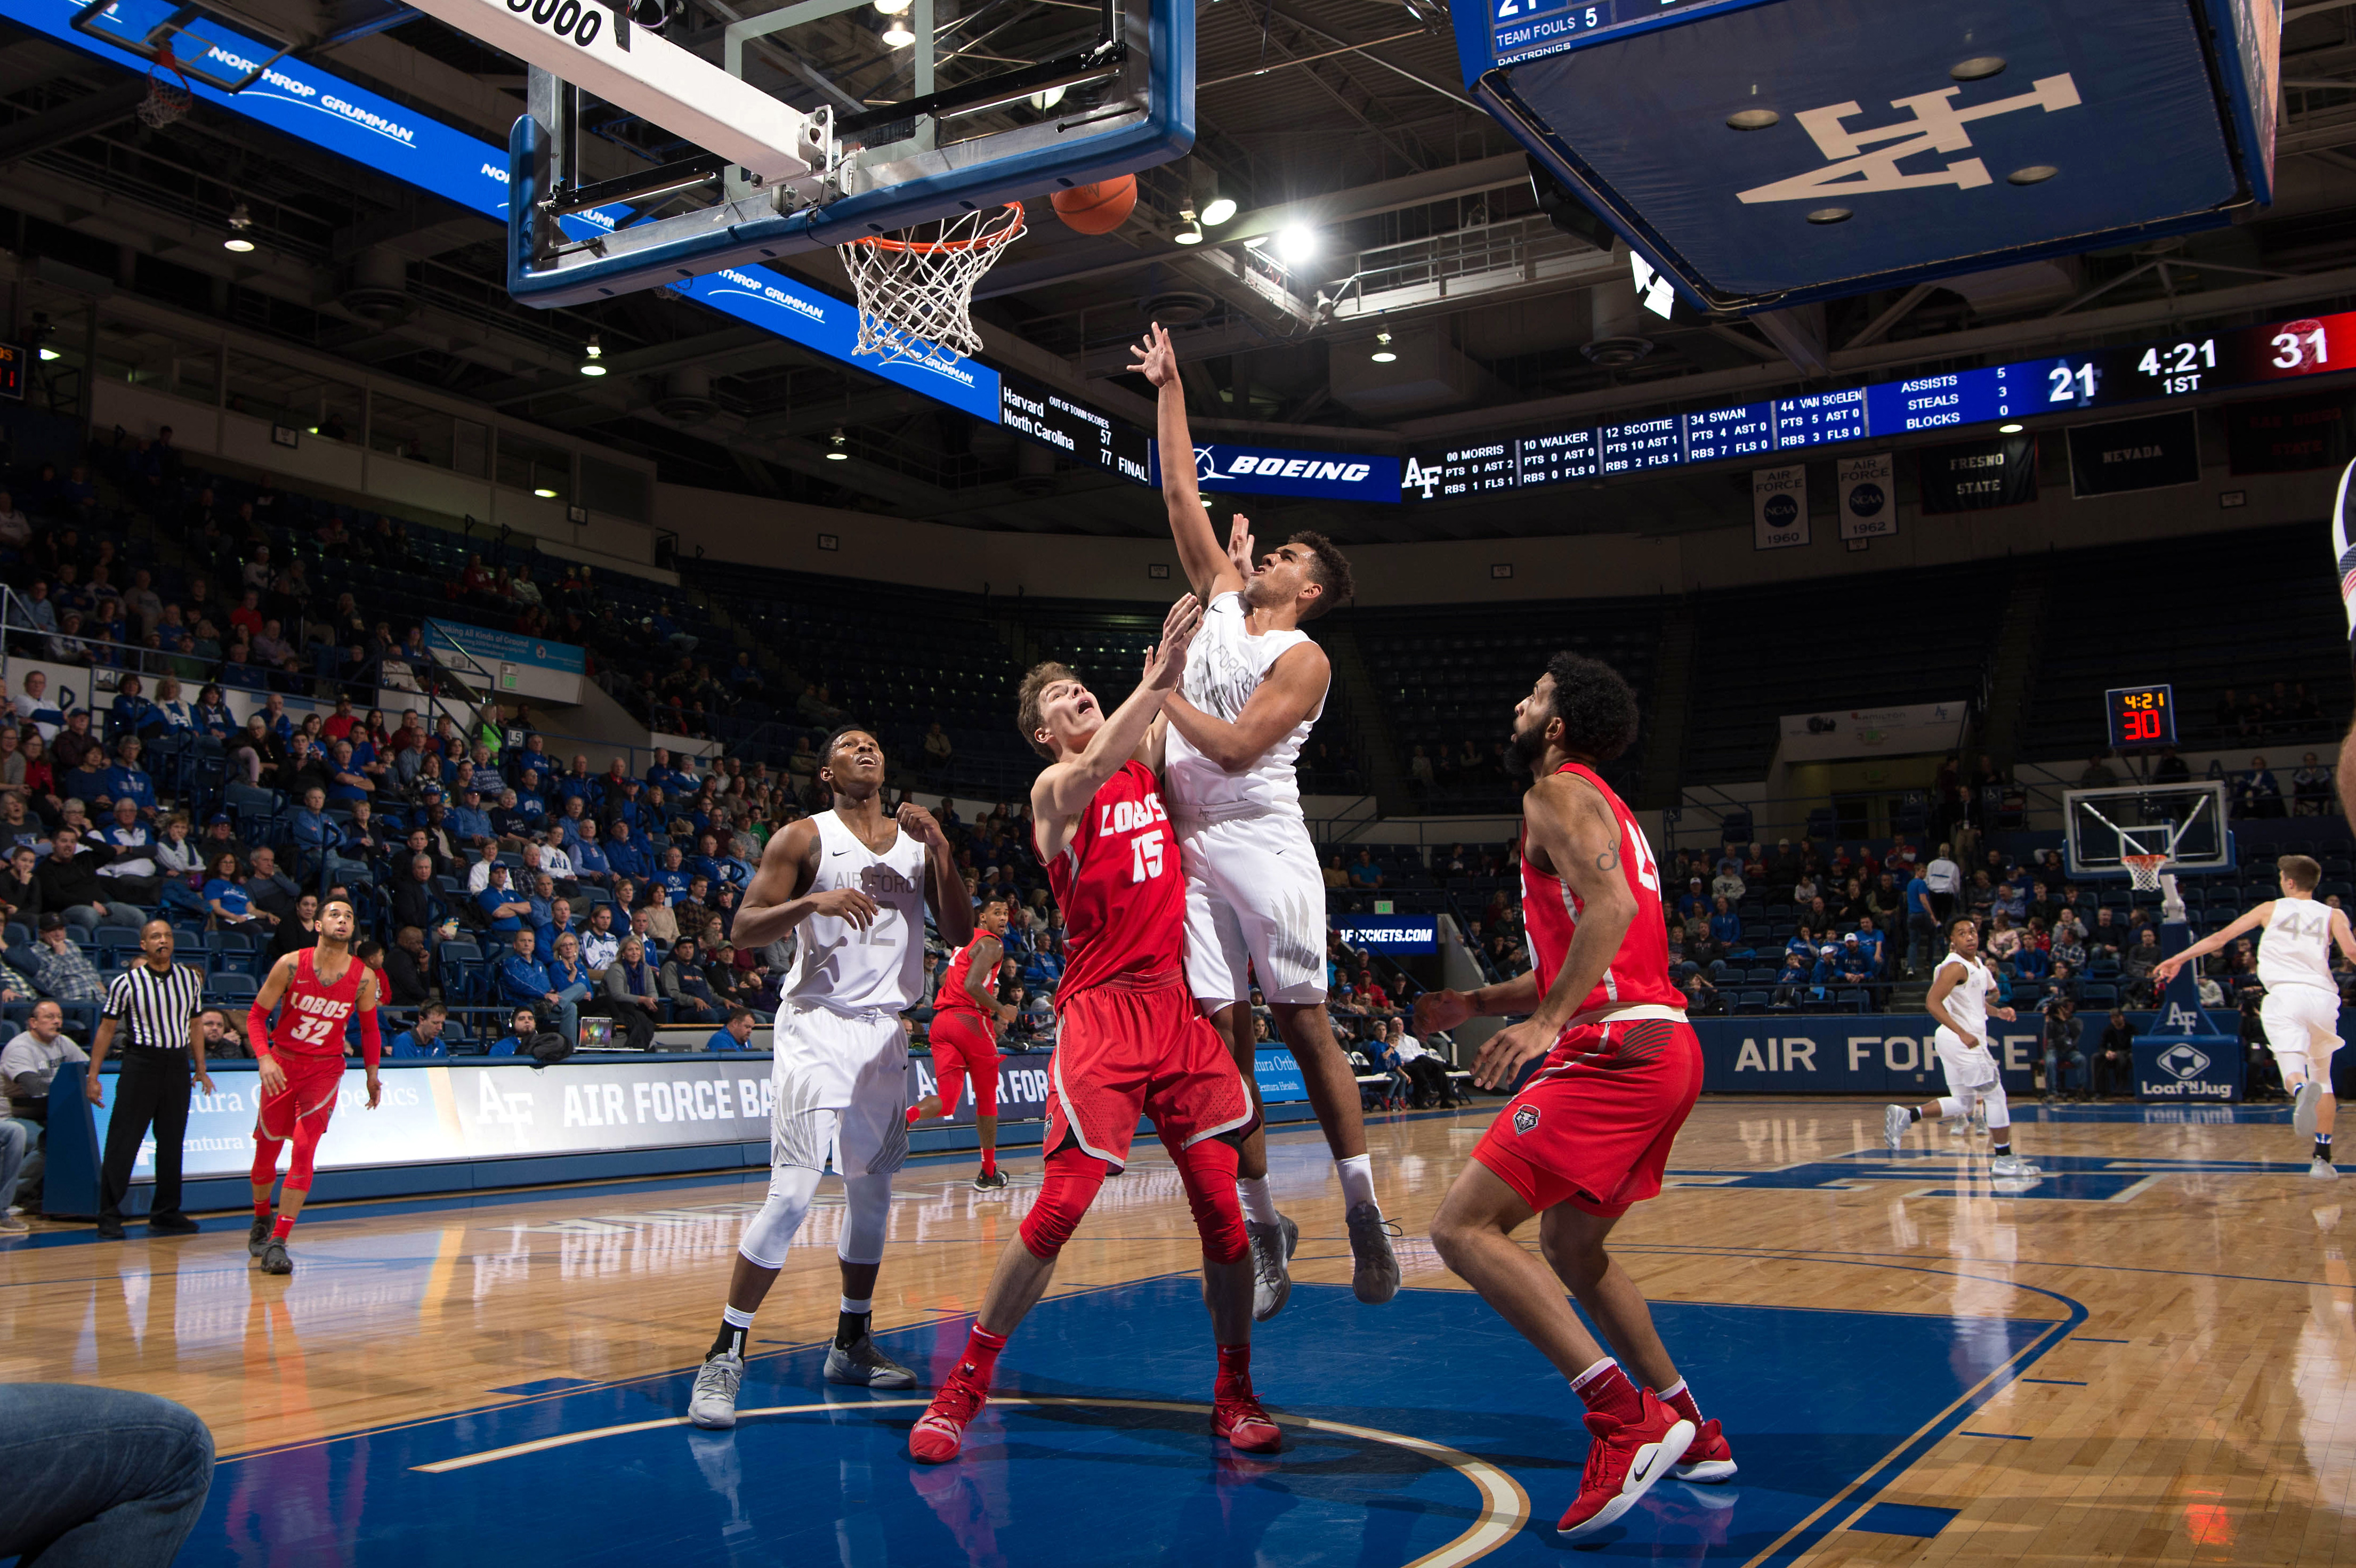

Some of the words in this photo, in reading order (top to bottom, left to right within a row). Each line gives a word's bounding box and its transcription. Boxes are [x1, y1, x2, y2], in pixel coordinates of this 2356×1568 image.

[1496, 28, 1531, 47] TEAM
[1534, 17, 1576, 36] FOULS
[1585, 7, 1597, 28] 5
[1497, 42, 1571, 67] DAKTRONICS
[320, 94, 414, 142] GRUMMAN
[764, 286, 824, 319] GRUMMAN
[2137, 338, 2216, 378] 4:21
[2269, 328, 2328, 370] 31
[925, 357, 974, 384] GRUMMAN
[1900, 375, 1958, 394] ASSISTS
[1996, 367, 2006, 379] 5
[2048, 362, 2095, 403] 21
[2162, 373, 2201, 395] 1ST
[1780, 401, 1795, 412] 44
[1800, 396, 1819, 409] VAN
[1822, 390, 1862, 406] SOELEN
[1907, 392, 1959, 411] STEALS
[1998, 385, 2007, 398] 3
[1004, 386, 1044, 418] Harvard
[1100, 429, 1111, 446] 57
[1049, 396, 1060, 409] OUT
[1061, 400, 1070, 412] OF
[1070, 403, 1087, 421] TOWN
[1087, 411, 1109, 430] SCORES
[1690, 414, 1705, 426] 34
[1708, 407, 1746, 423] SWAN
[1780, 416, 1803, 429] PTS
[1811, 414, 1819, 424] 5
[1825, 409, 1849, 422] AST
[1852, 408, 1859, 418] 0
[1906, 411, 1960, 430] BLOCKS
[1999, 405, 2008, 416] 0
[1605, 427, 1619, 438] 12
[1624, 418, 1673, 435] SCOTTIE
[1691, 430, 1714, 442] PTS
[1720, 427, 1726, 438] 4
[1734, 423, 1756, 436] AST
[1760, 422, 1767, 432] 0
[1781, 434, 1805, 447] RBS
[1812, 432, 1820, 442] 3
[1827, 429, 1849, 440] FLS
[1853, 426, 1861, 437] 0
[1004, 408, 1032, 434] North
[1034, 421, 1075, 451] Carolina
[1100, 448, 1112, 466] 77
[1118, 456, 1148, 482] FINAL
[1523, 439, 1537, 451] 10
[1539, 432, 1588, 449] WALKER
[1606, 442, 1627, 454] PTS
[1631, 440, 1644, 451] 10
[1647, 436, 1668, 449] AST
[1672, 435, 1677, 445] 1
[1691, 447, 1715, 460] RBS
[1721, 446, 1728, 456] 7
[1736, 441, 1757, 453] FLS
[1761, 439, 1768, 449] 0
[1446, 452, 1458, 462] 00
[1461, 444, 1504, 460] MORRIS
[1523, 455, 1545, 466] PTS
[1551, 452, 1558, 463] 0
[1564, 448, 1585, 460] AST
[1588, 447, 1594, 457] 0
[1605, 459, 1628, 472] RBS
[1635, 457, 1642, 468] 2
[1648, 454, 1669, 466] FLS
[1673, 452, 1678, 463] 1
[1949, 453, 2005, 471] FRESNO
[2102, 444, 2164, 464] NEVADA
[1228, 455, 1370, 481] BOEING
[1445, 466, 1465, 478] PTS
[1472, 464, 1479, 474] 0
[1484, 460, 1504, 472] AST
[1507, 459, 1513, 469] 2
[1523, 472, 1545, 484] RBS
[1551, 470, 1558, 479] 0
[1564, 466, 1585, 478] FLS
[1588, 464, 1595, 474] 0
[1766, 470, 1790, 480] AIR
[1840, 467, 1890, 482] FORCE
[1853, 459, 1876, 470] AIR
[1401, 457, 1442, 499] AF
[1445, 483, 1466, 495] RBS
[1473, 481, 1478, 491] 1
[1484, 478, 1504, 489] FLS
[1508, 476, 1513, 486] 1
[1756, 479, 1803, 493] FORCE
[1956, 479, 2001, 496] STATE
[1764, 504, 1798, 516] NCAA
[1849, 492, 1884, 507] NCAA
[1853, 521, 1887, 534] 1962
[1766, 532, 1800, 545] 1960
[2125, 692, 2165, 709] 4:21
[2123, 709, 2161, 740] 30
[510, 731, 521, 743] L5
[1099, 792, 1168, 838] LOBOS
[1131, 829, 1165, 884] 15
[835, 871, 862, 890] AIR
[2277, 912, 2325, 945] 44
[291, 992, 352, 1019] LOBOS
[2166, 1001, 2198, 1036] AF
[291, 1014, 334, 1046] 32
[1734, 1037, 1817, 1072] AIR
[1847, 1034, 2038, 1071] FOE
[1008, 1069, 1049, 1103] FOR
[563, 1084, 628, 1127] AIR
[633, 1079, 735, 1124] FORCE
